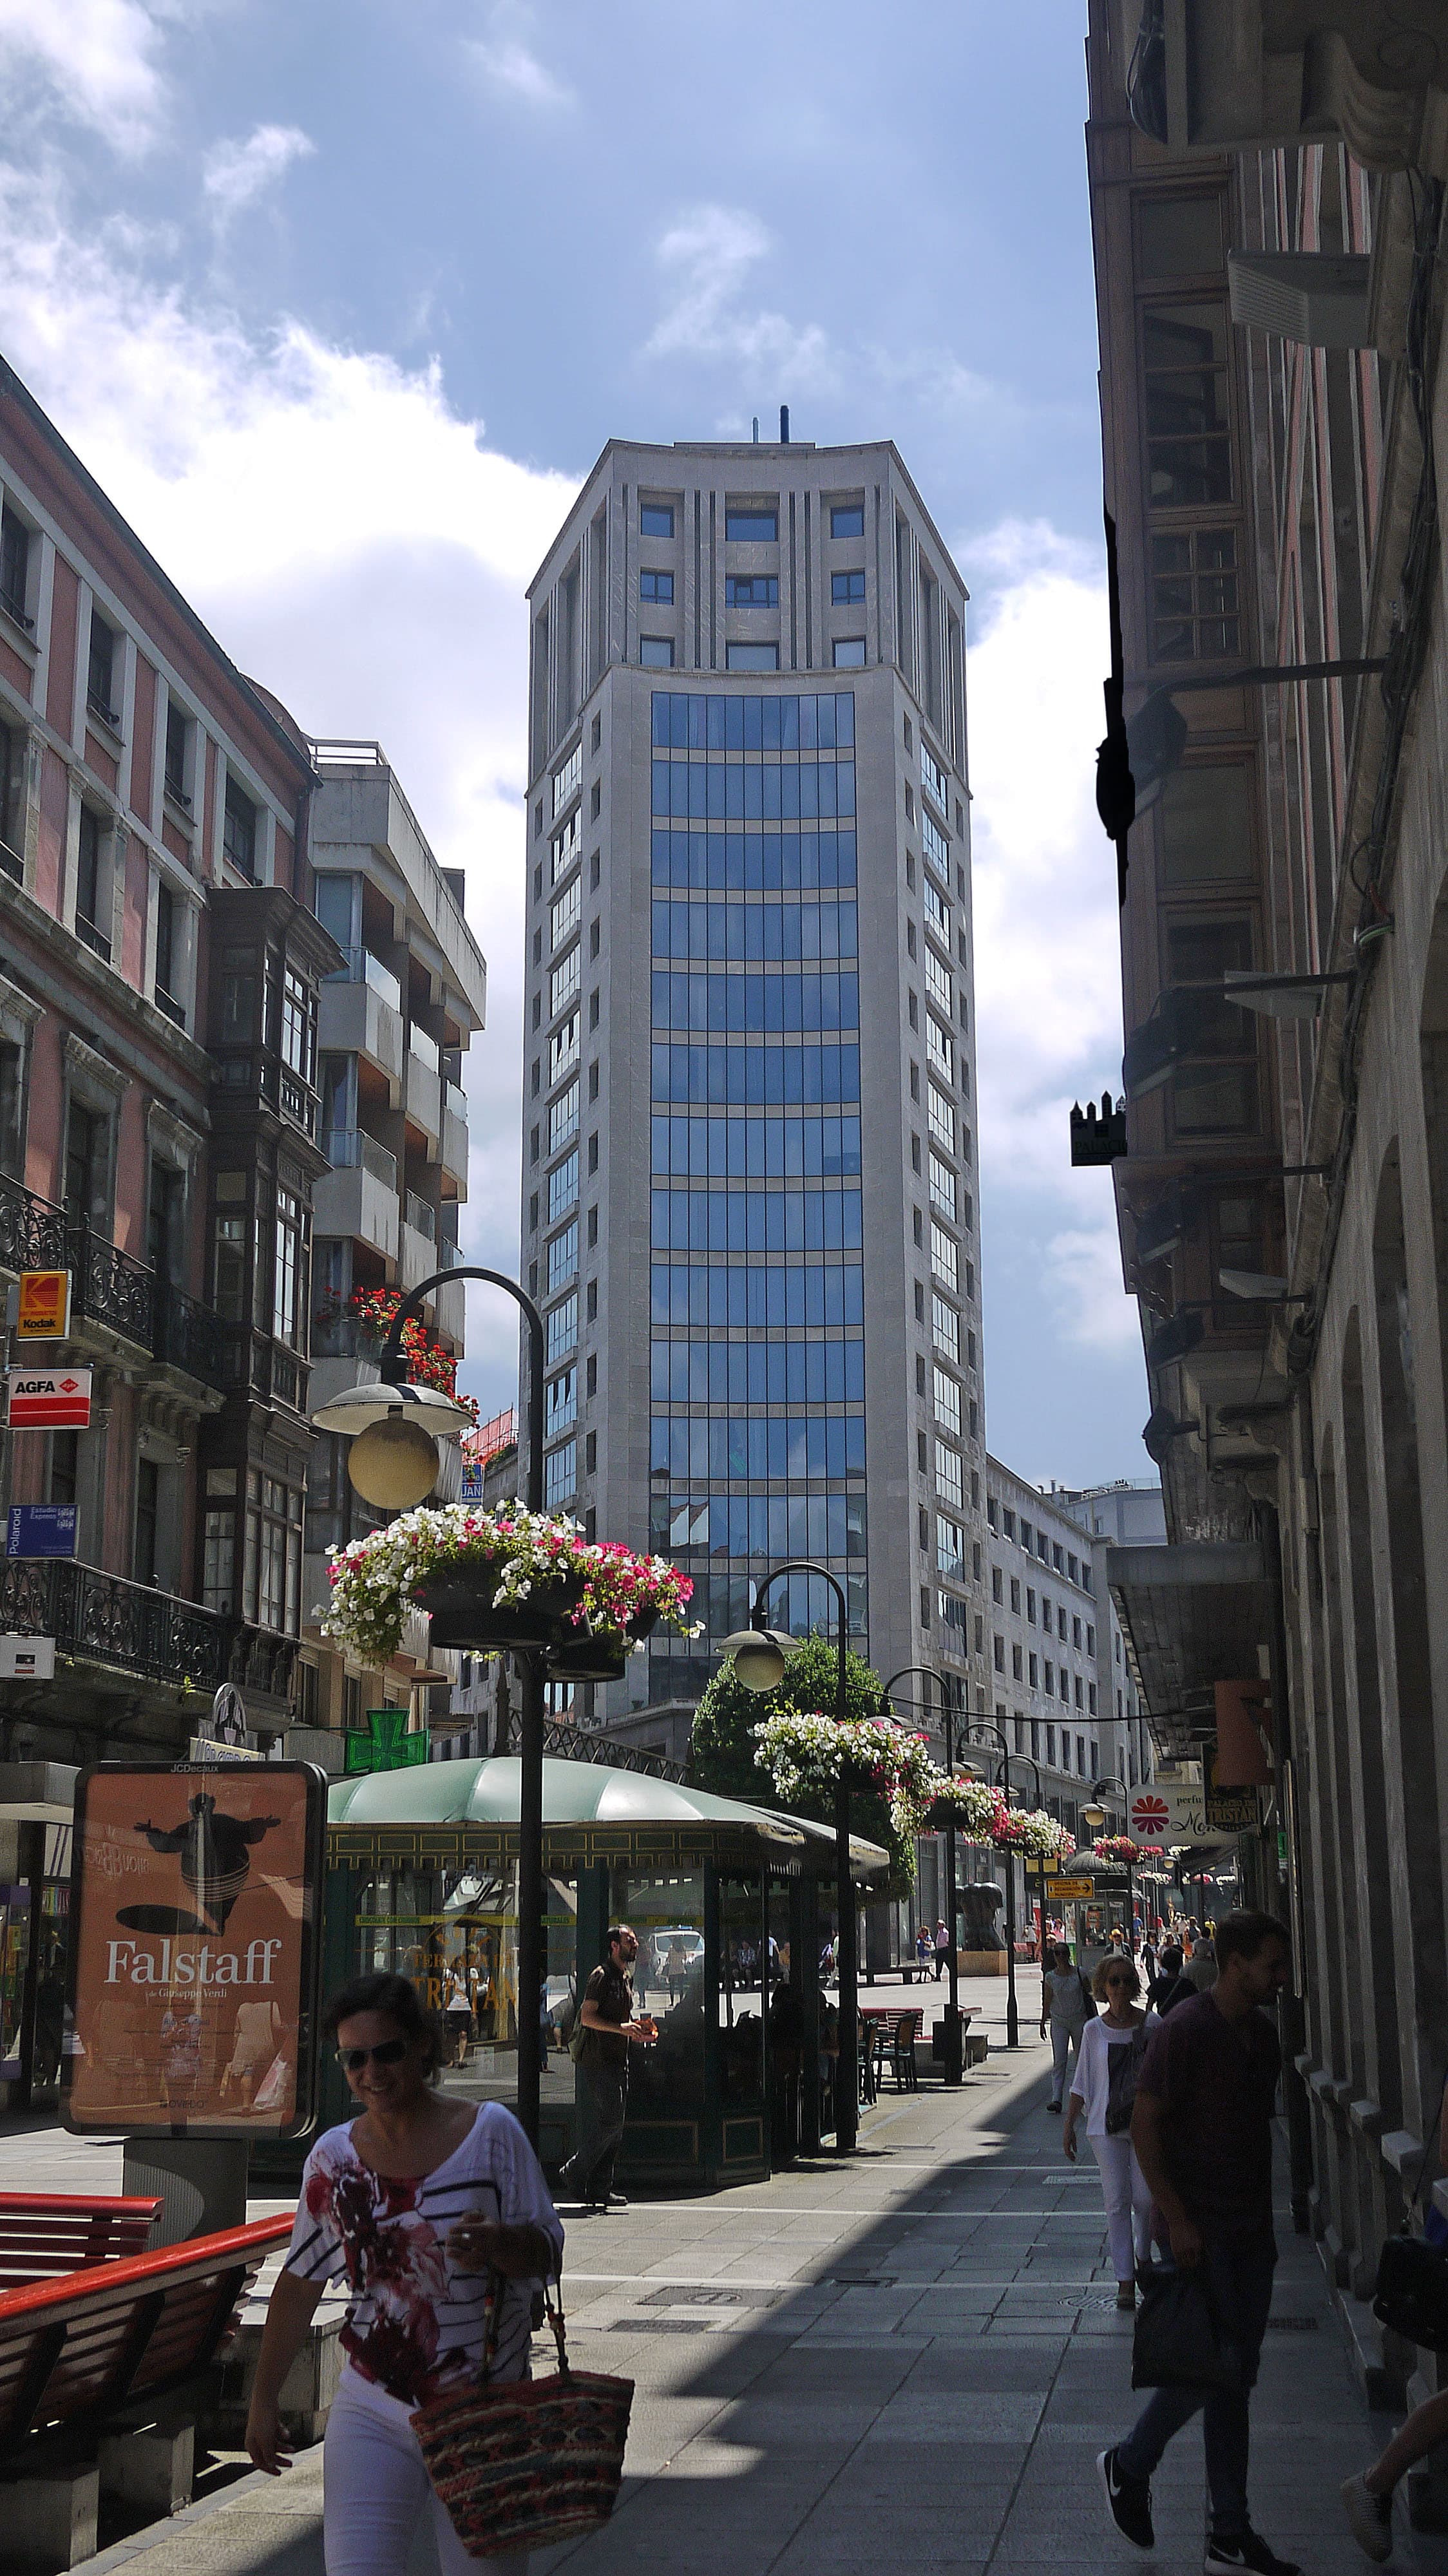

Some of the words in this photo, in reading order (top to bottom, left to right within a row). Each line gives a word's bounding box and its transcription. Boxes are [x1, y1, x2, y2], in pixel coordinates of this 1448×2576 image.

[23, 1319, 56, 1328] Kodak
[15, 1381, 55, 1394] AGFA
[9, 1508, 21, 1554] Polaroid
[171, 1764, 218, 1772] JCDecaux
[104, 1938, 282, 1984] Falstaff
[158, 1988, 202, 2000] Giuseppe
[204, 1989, 227, 1998] Verdi
